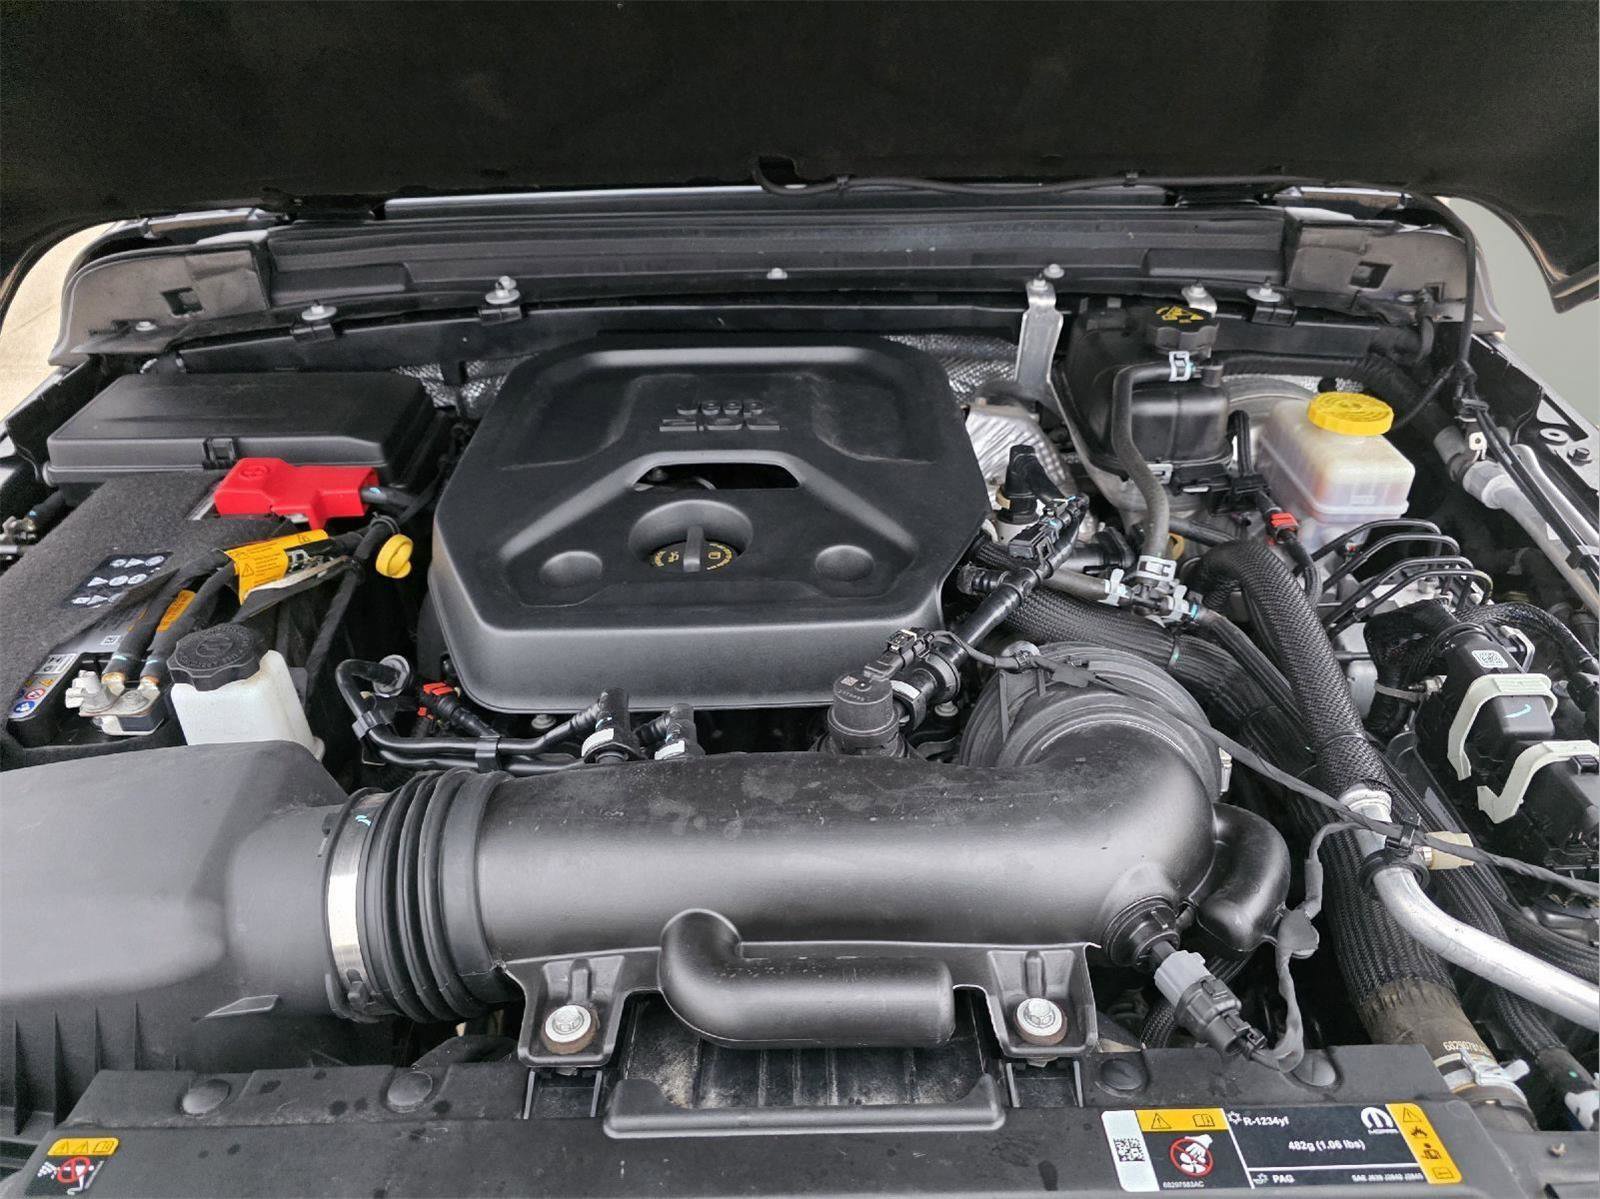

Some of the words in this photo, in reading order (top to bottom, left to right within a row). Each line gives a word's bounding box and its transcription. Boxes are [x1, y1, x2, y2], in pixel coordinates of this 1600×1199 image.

[1242, 1115, 1290, 1128] R-1234yf
[1288, 1140, 1316, 1152] 482g
[1342, 1139, 1366, 1151] lbs)
[1272, 1174, 1296, 1184] PAG
